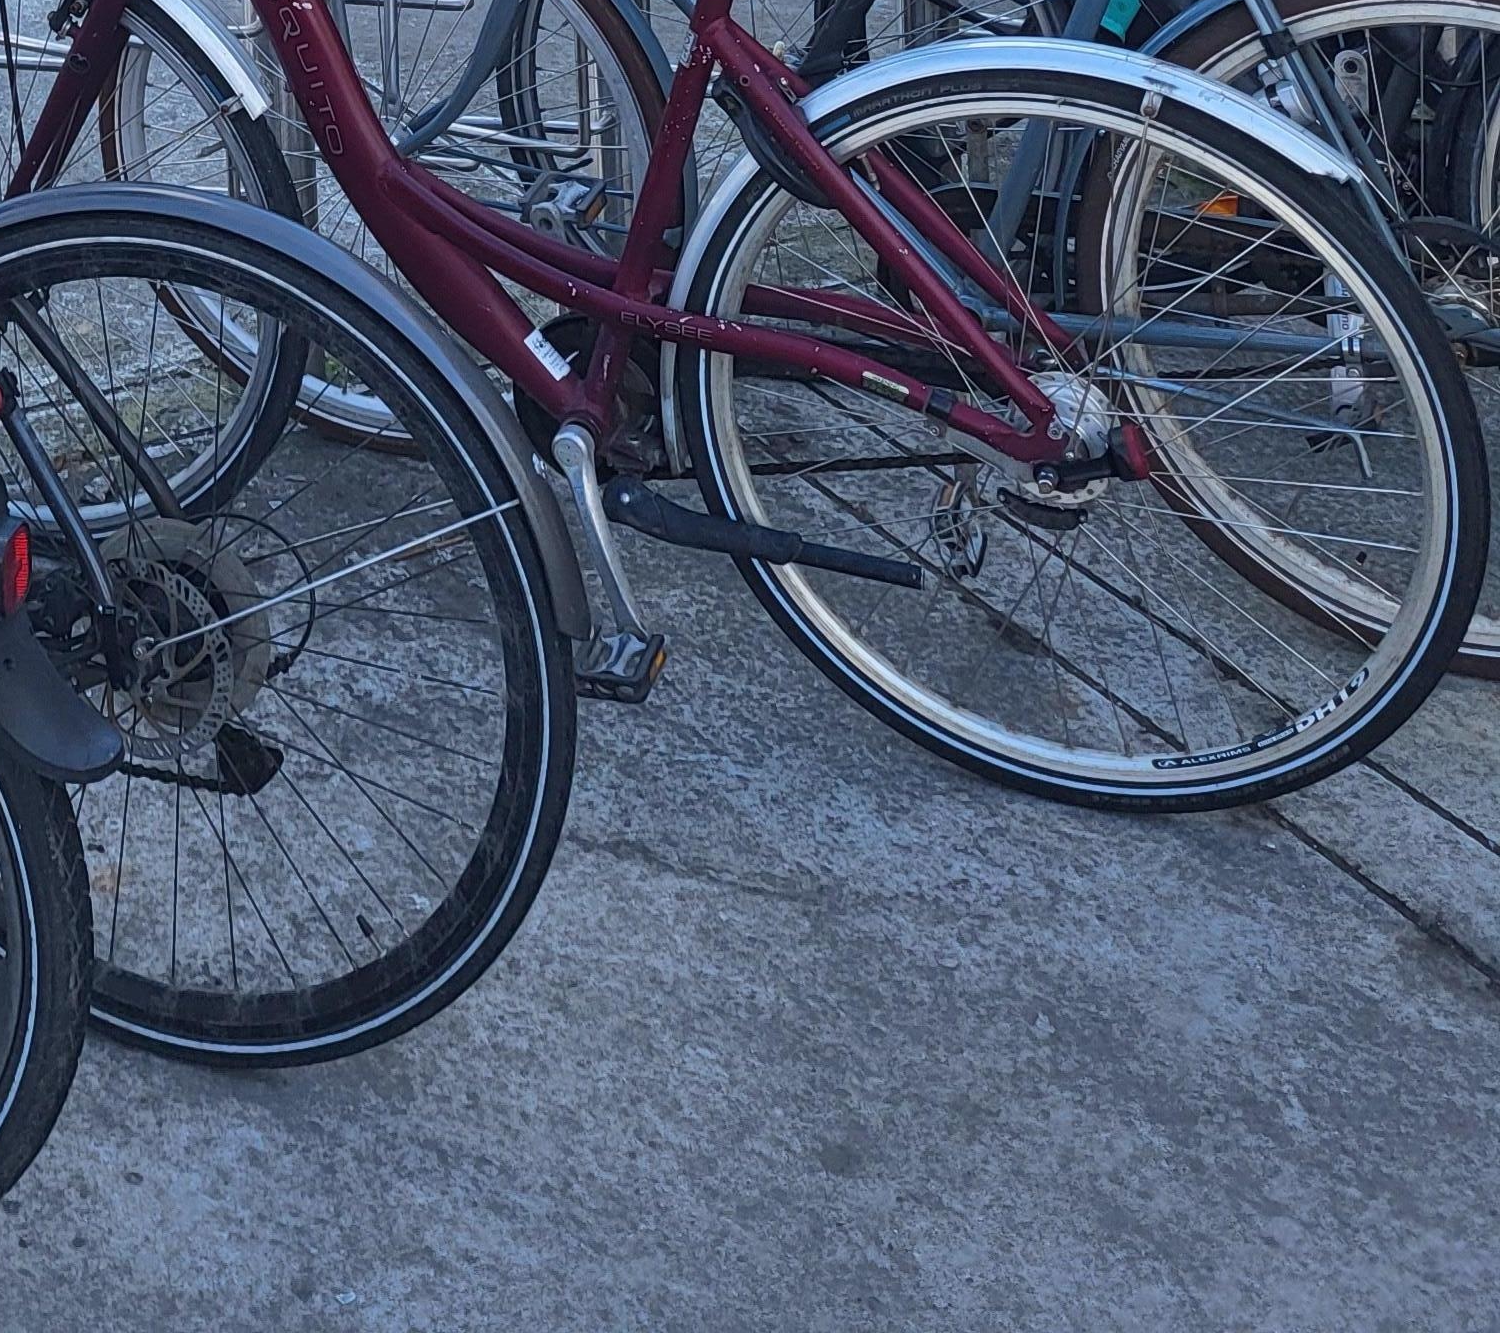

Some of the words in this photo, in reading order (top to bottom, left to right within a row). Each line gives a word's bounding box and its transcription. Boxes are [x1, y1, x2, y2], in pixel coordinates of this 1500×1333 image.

[852, 87, 932, 118] MARATHON
[620, 311, 713, 342] ELYSEE
[1295, 667, 1370, 734] DH19
[1180, 745, 1252, 766] ALEXRIMS
